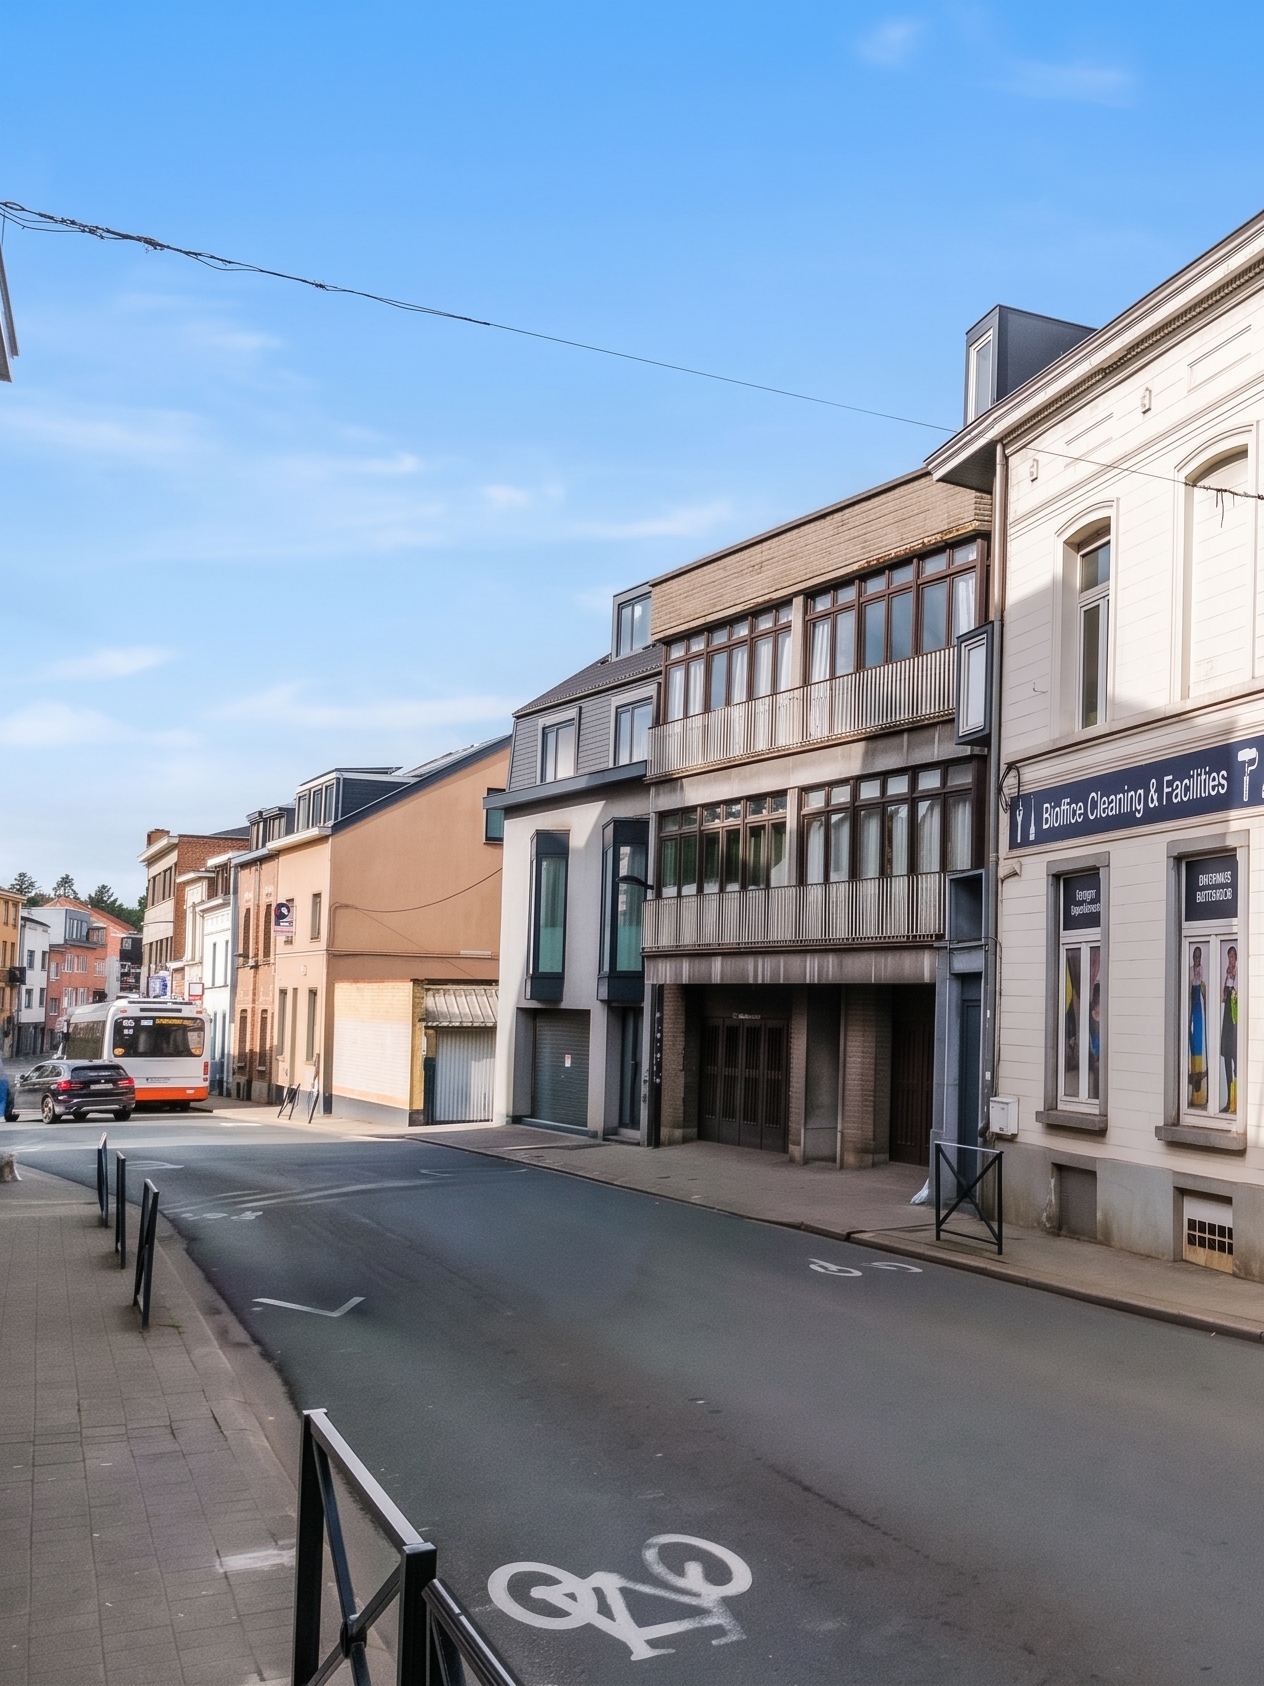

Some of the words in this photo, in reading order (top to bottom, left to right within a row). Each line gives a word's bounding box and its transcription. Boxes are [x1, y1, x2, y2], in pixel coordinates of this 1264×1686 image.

[1042, 797, 1084, 830] Bioffice
[1087, 785, 1144, 818] Cleaning
[1148, 779, 1159, 808] &
[1163, 766, 1228, 803] Facilities
